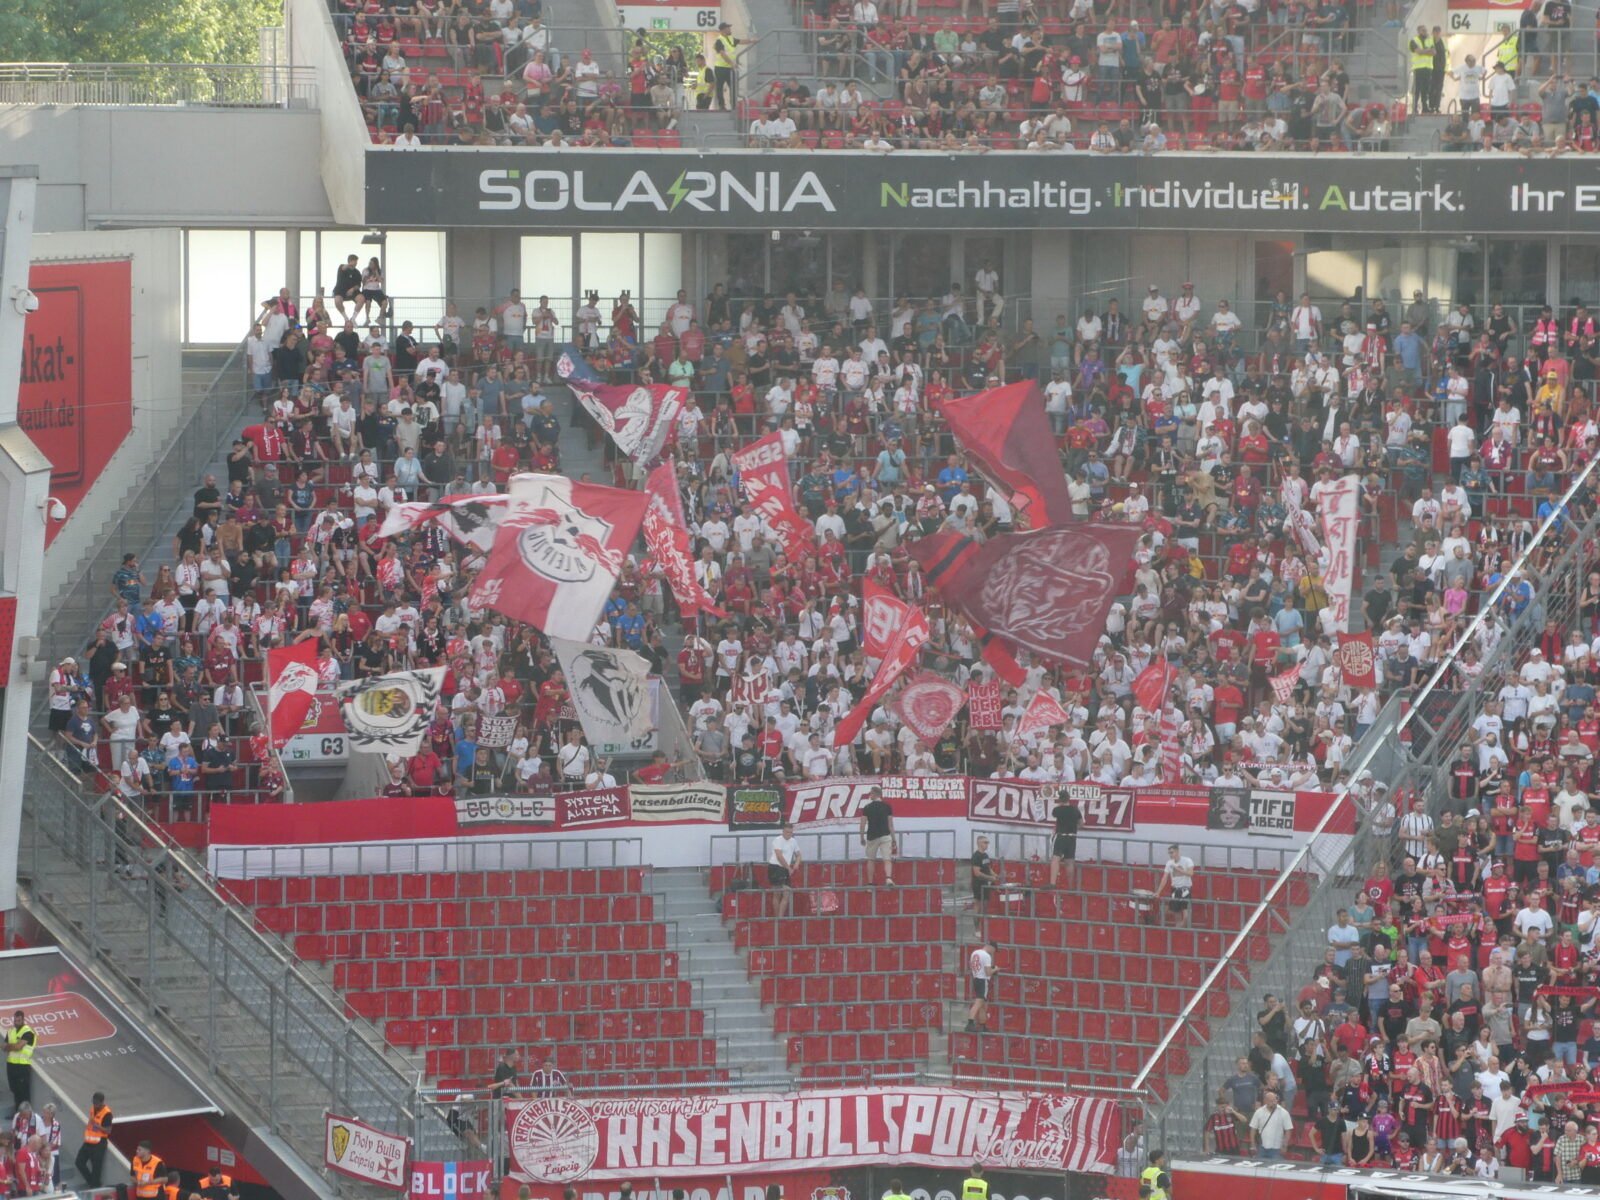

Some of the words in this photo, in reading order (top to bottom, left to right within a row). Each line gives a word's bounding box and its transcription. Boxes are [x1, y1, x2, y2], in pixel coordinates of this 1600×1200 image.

[697, 10, 717, 27] G5
[1450, 13, 1471, 30] G4
[479, 169, 838, 213] SOLARNIA
[880, 180, 1102, 214] Nachhaltig.
[1114, 180, 1309, 210] Individuell.
[1319, 183, 1466, 212] Autark.
[1511, 182, 1566, 212] Ihr
[970, 697, 1001, 712] DER
[971, 712, 1002, 728] RBL
[321, 737, 344, 756] G3
[881, 777, 903, 788] WAS
[906, 778, 919, 789] ES
[922, 778, 965, 791] KOSTET
[564, 793, 619, 808] SYSTEMA
[632, 792, 722, 807] rasenballisten
[1250, 798, 1294, 817] TIFO
[567, 804, 621, 820] ALISTRA
[1249, 815, 1293, 829] LIBERO
[515, 1099, 592, 1143] RASENBALLSPORT
[606, 1095, 1031, 1168] RASENBALLSPORT
[352, 1130, 376, 1153] Holy
[376, 1138, 402, 1161] Bulls
[348, 1150, 375, 1171] Leipzig
[411, 1170, 490, 1195] BLOCK
